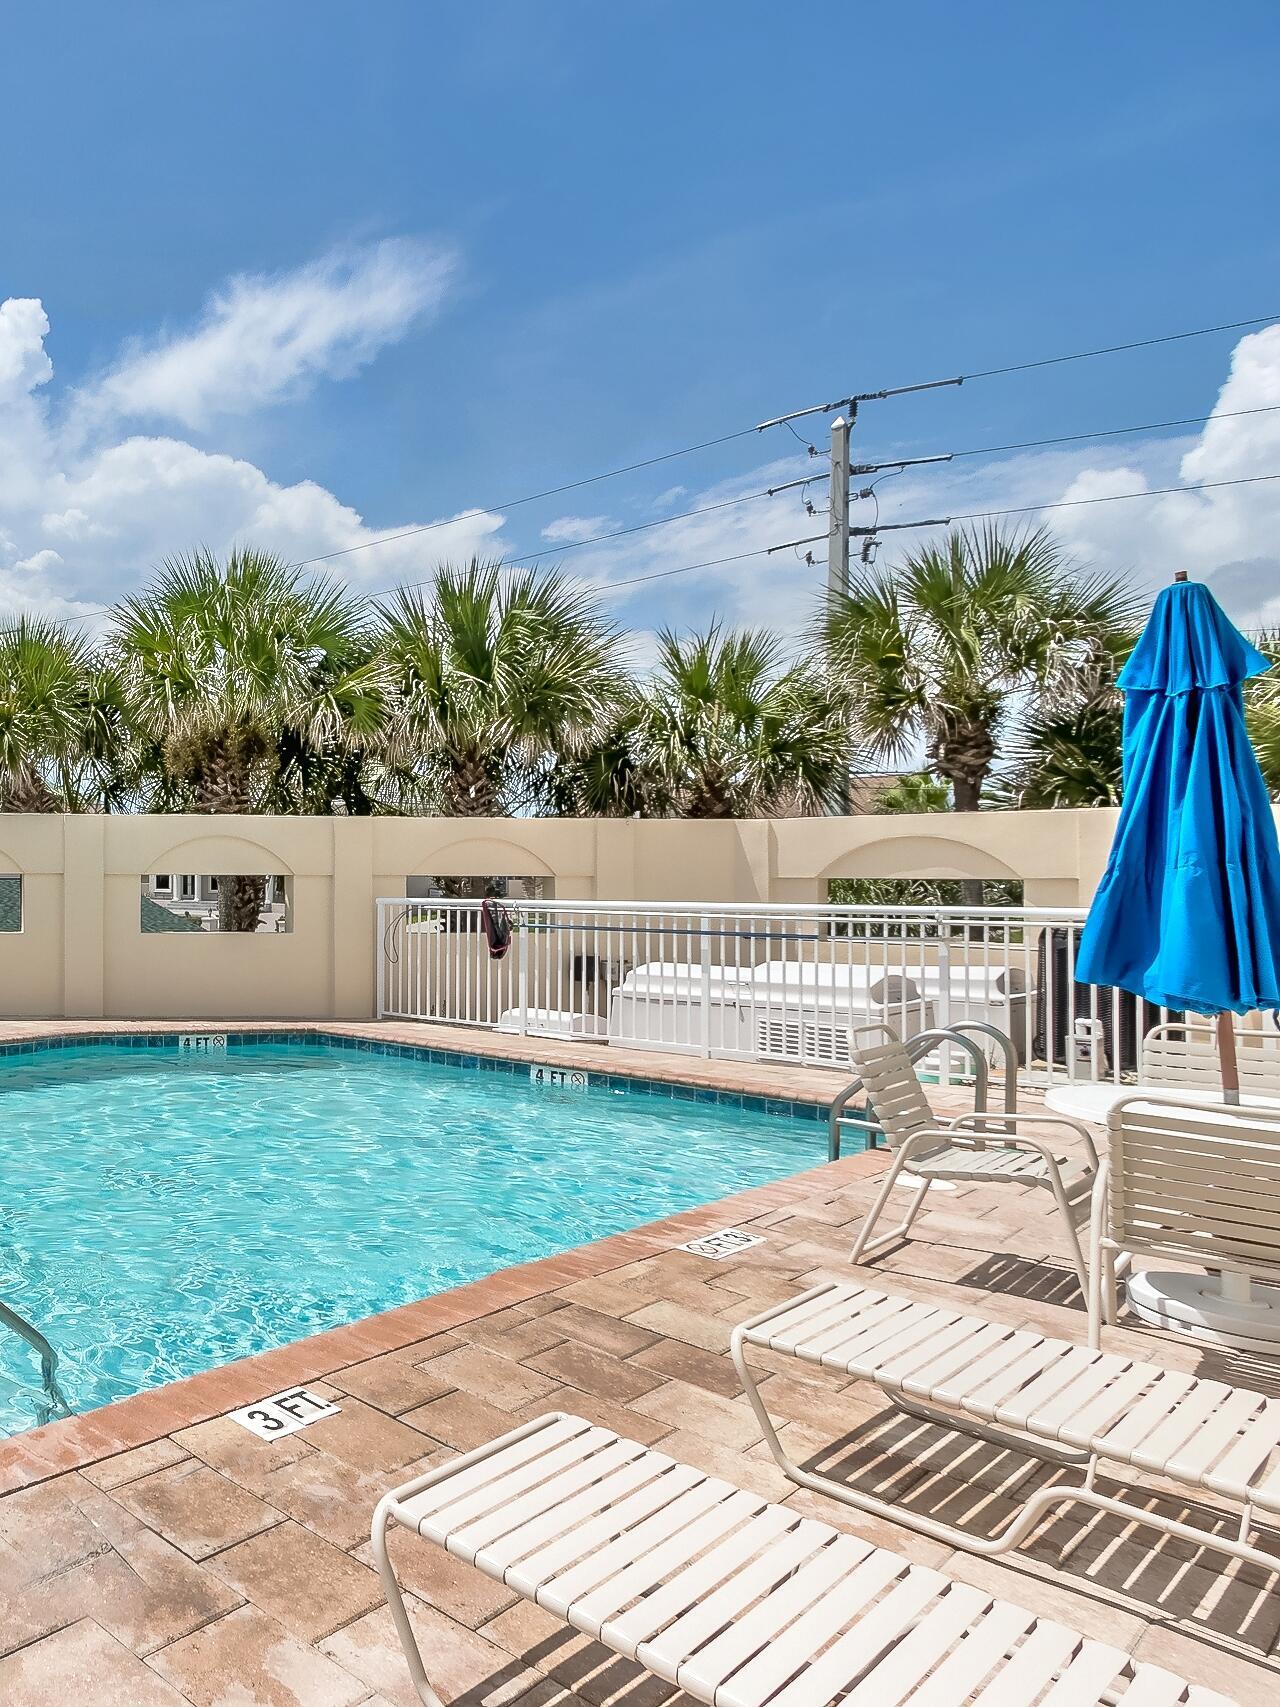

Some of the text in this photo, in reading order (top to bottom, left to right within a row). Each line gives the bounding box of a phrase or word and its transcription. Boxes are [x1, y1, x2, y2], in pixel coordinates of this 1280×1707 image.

[183, 1037, 210, 1047] 4 FT
[535, 1069, 567, 1083] 4 FT
[247, 1390, 332, 1431] 3 FT.
